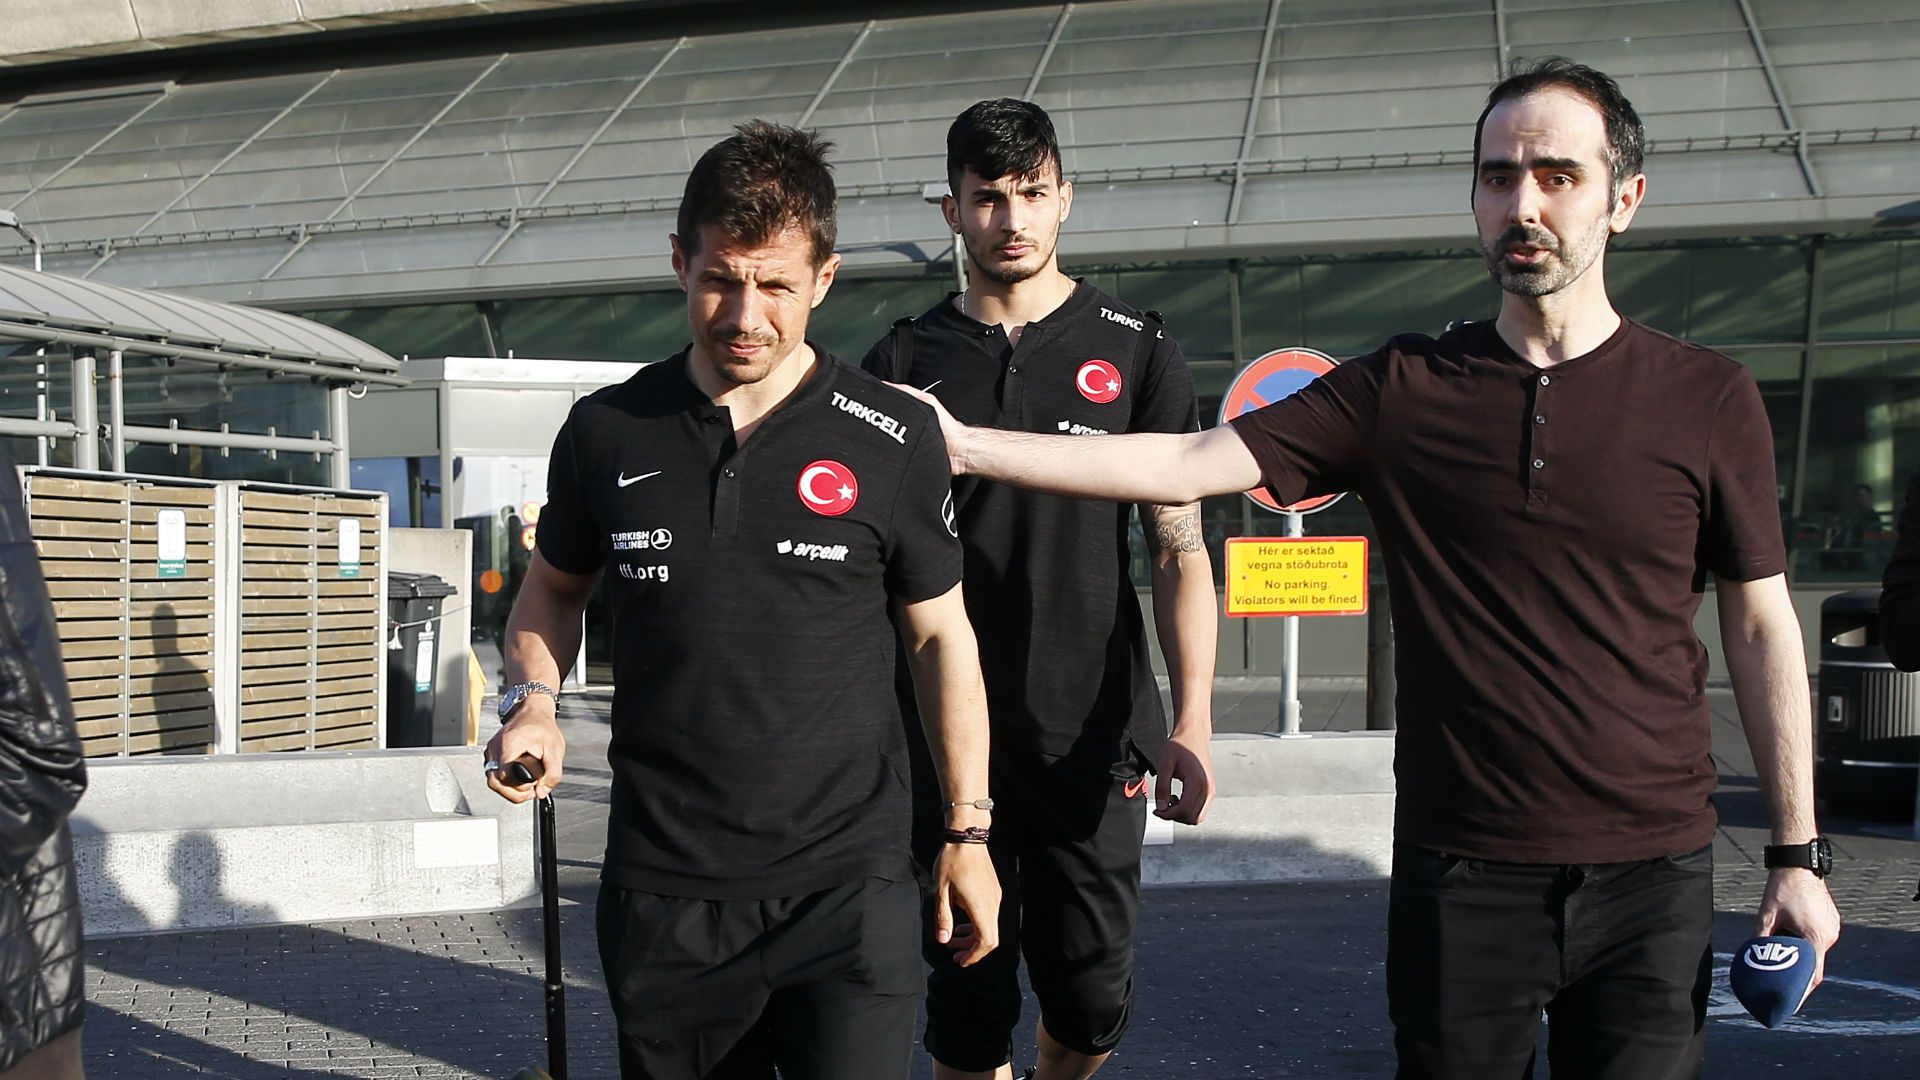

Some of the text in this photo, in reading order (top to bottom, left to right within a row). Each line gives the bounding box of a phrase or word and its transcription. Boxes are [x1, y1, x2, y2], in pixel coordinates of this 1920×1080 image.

[831, 391, 908, 445] TURKCELL
[611, 530, 650, 542] TURKISH
[613, 540, 650, 550] AIRLINES
[1258, 546, 1335, 555] Hér er sektað
[793, 541, 849, 562] arçelik
[1247, 560, 1348, 572] vegna stöðubrota
[1265, 580, 1281, 589] No
[1235, 595, 1360, 605] Violators will be fined.
